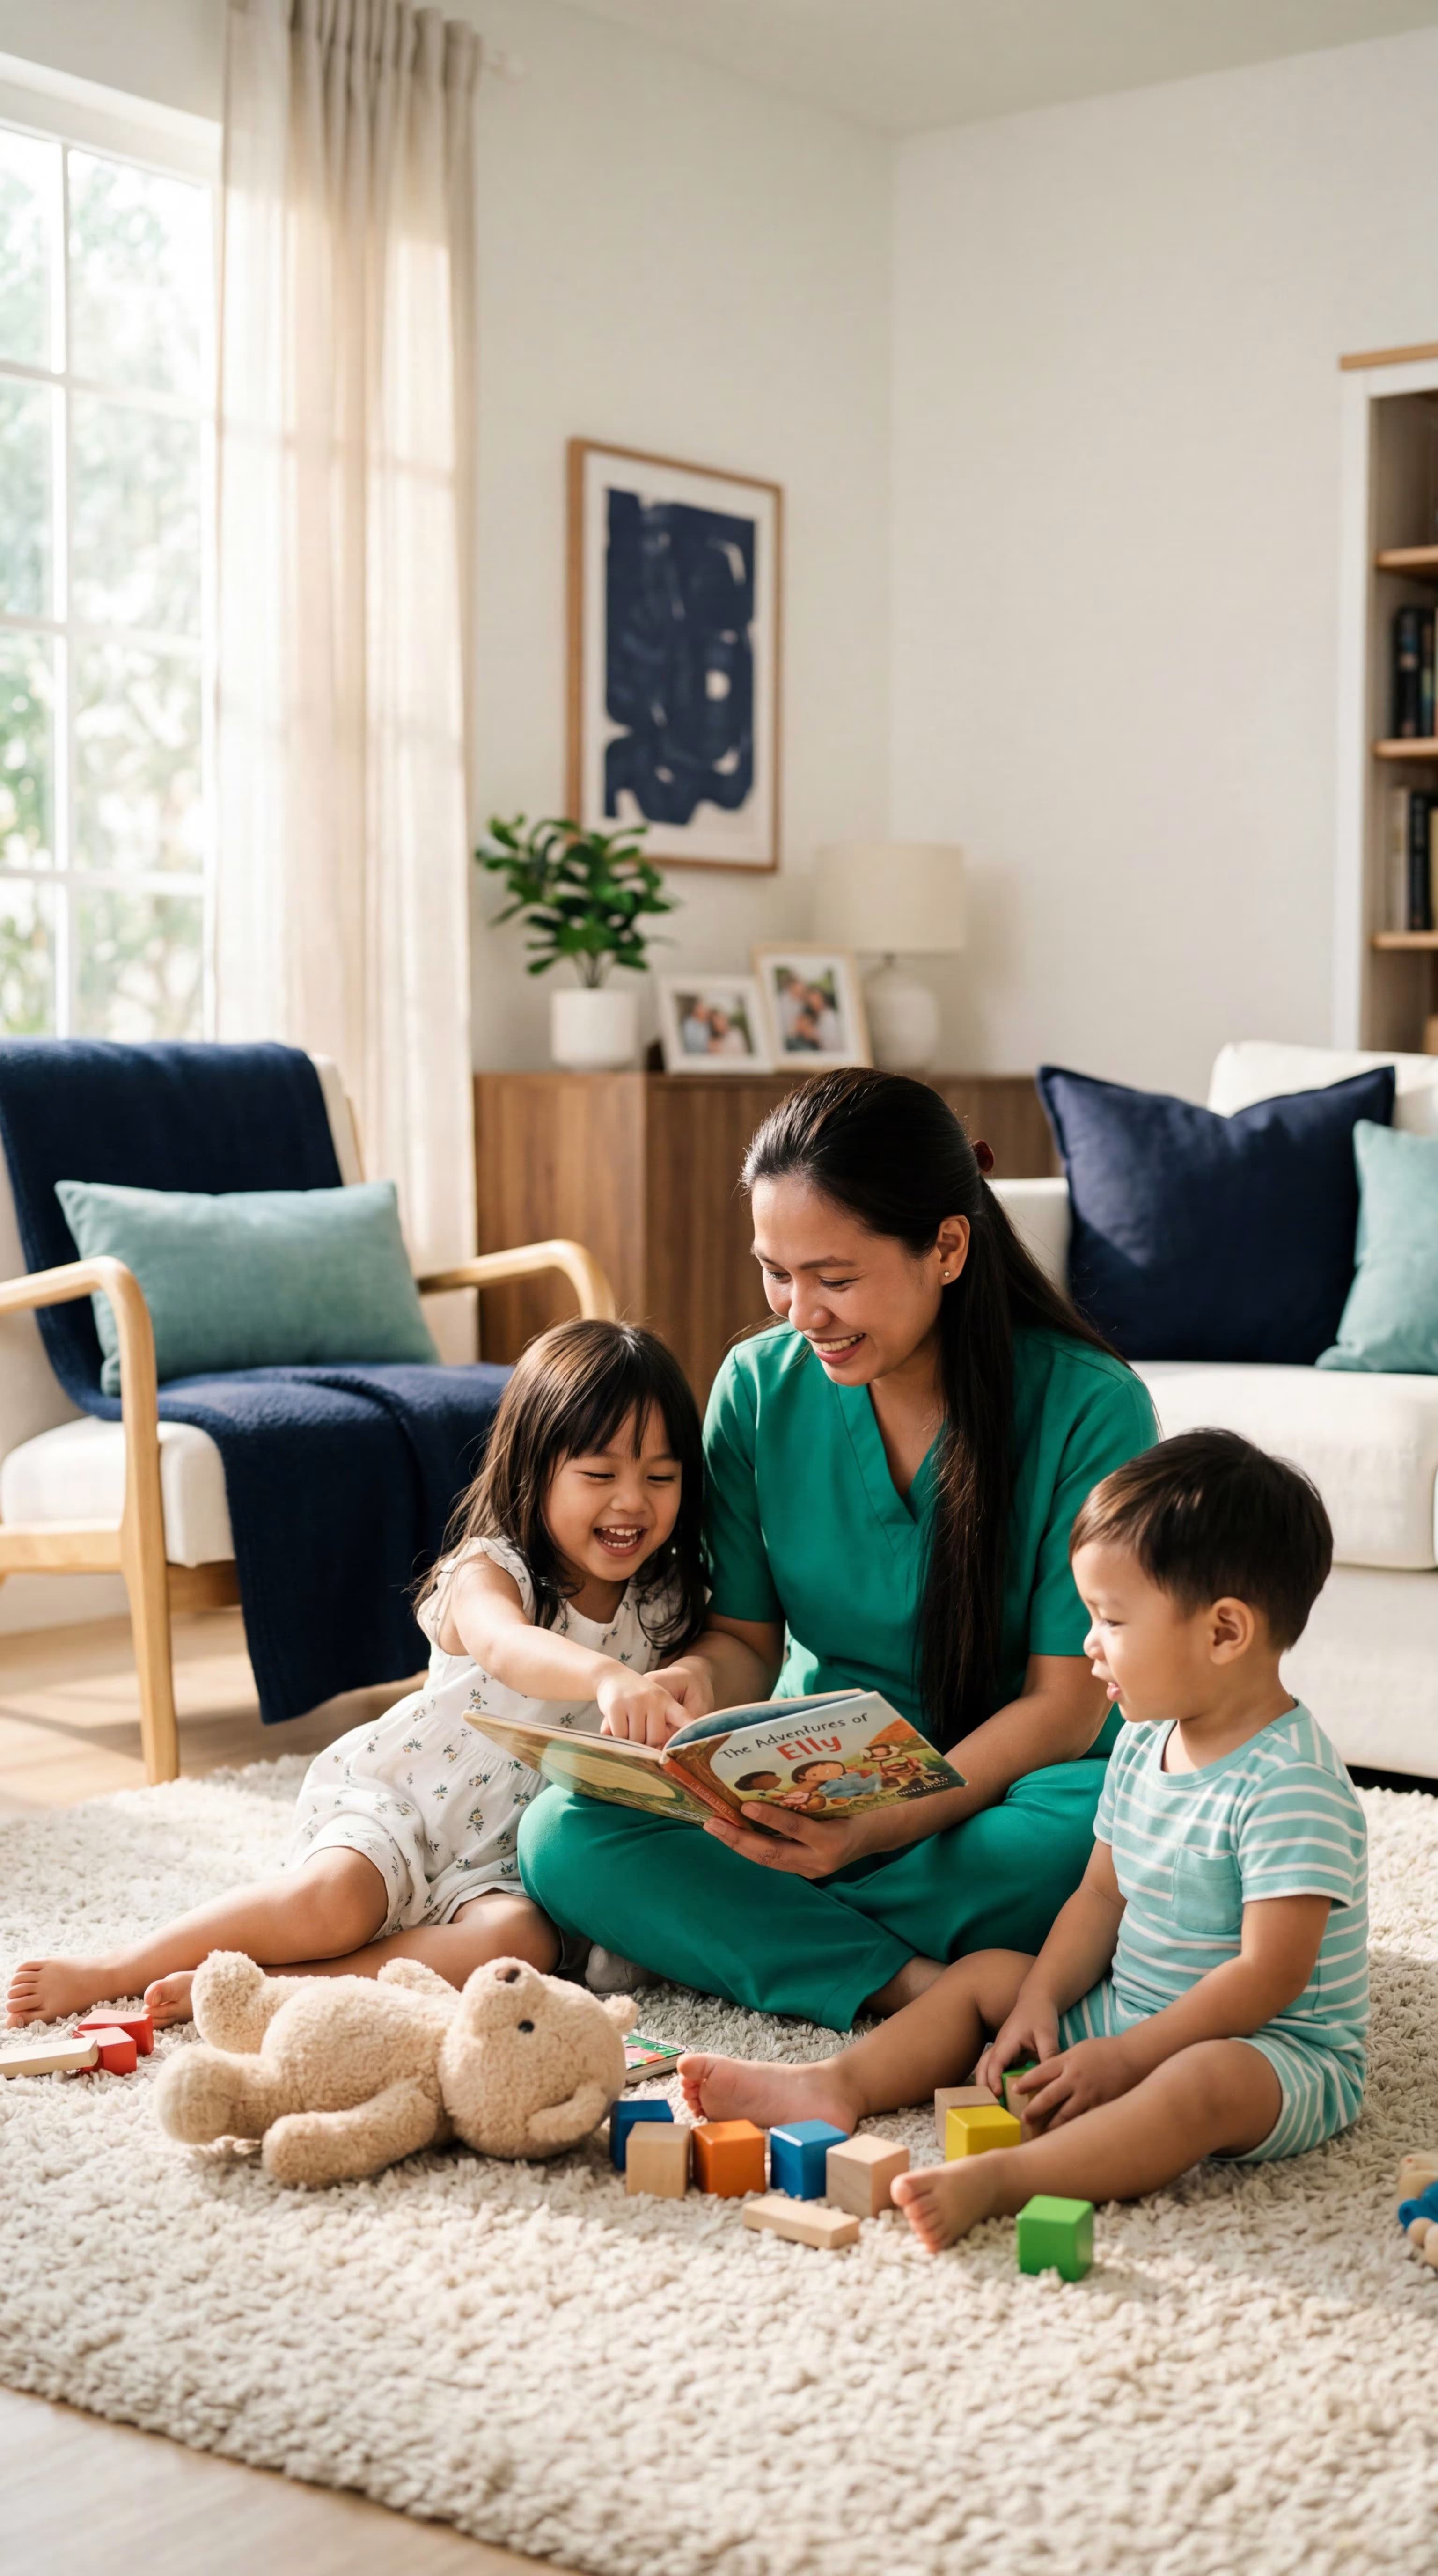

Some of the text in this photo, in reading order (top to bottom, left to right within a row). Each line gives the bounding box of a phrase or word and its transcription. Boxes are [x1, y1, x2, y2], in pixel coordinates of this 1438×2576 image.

[718, 1746, 752, 1759] The
[755, 1719, 846, 1748] Adventures
[776, 1736, 842, 1761] Elly
